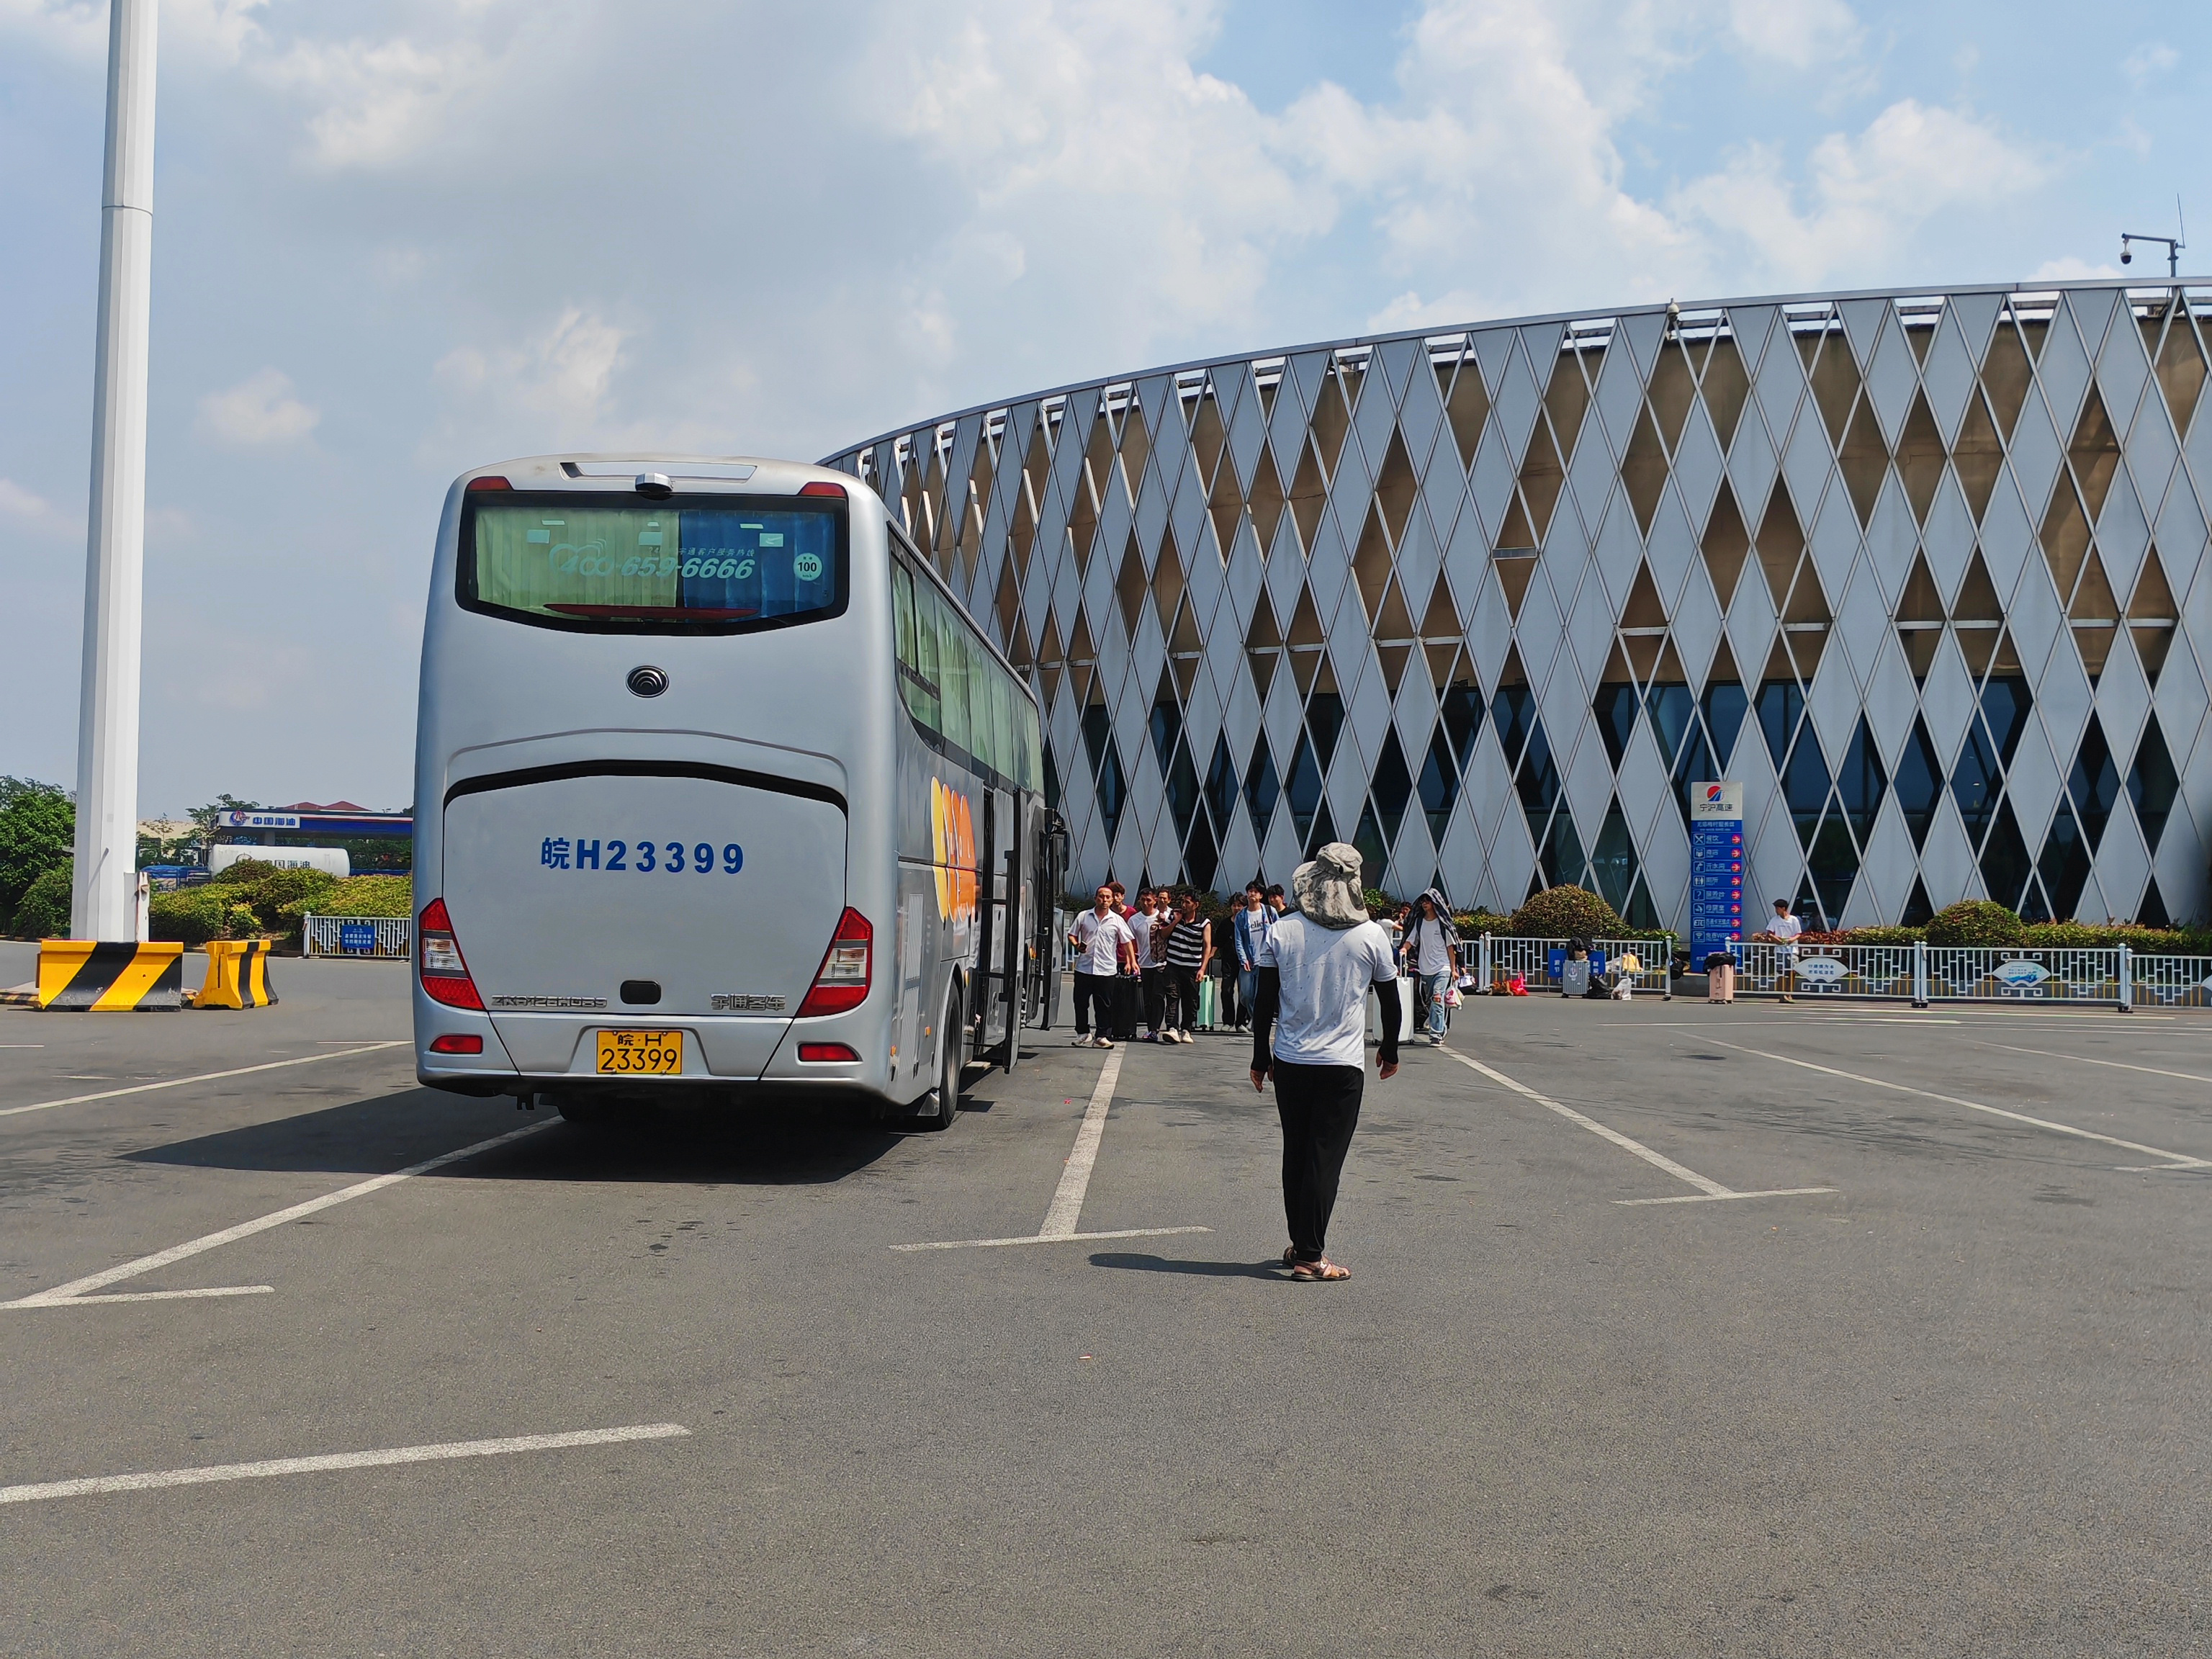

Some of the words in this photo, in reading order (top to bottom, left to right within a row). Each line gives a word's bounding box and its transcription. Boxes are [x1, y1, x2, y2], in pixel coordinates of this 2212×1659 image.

[560, 555, 755, 579] 400-659-6666
[797, 562, 817, 572] 100
[1699, 803, 1734, 811] 宁沪高速
[253, 816, 296, 827] 中国海油
[541, 837, 745, 875] 皖H23399
[267, 860, 311, 869] 国海油
[711, 994, 786, 1011] 宇通客车
[617, 1033, 662, 1047] 皖·H
[601, 1048, 678, 1071] 23399
